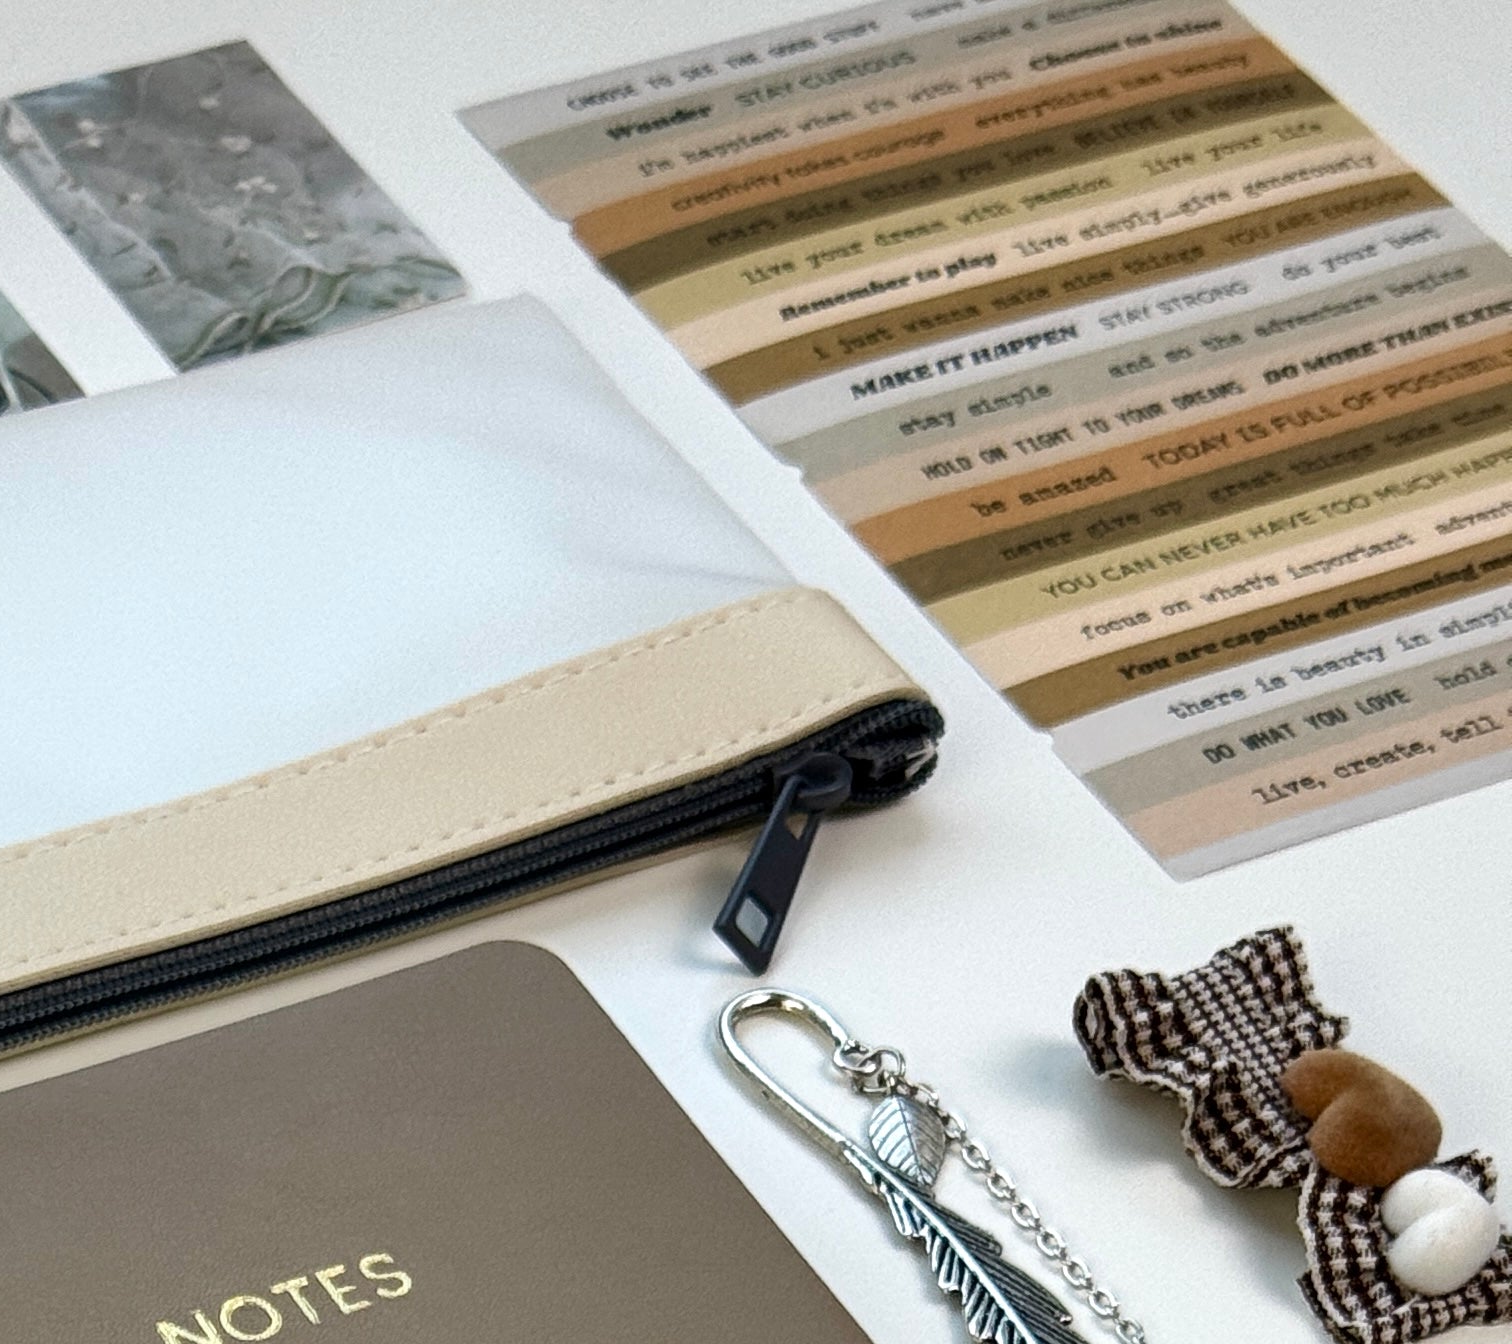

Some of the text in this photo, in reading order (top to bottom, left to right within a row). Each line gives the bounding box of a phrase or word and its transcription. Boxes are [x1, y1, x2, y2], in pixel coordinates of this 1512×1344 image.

[606, 106, 710, 139] Wonder
[1141, 151, 1195, 175] live
[1204, 133, 1262, 161] your
[671, 173, 780, 211] creativity
[783, 154, 849, 177] takes
[1012, 234, 1068, 256] live
[1242, 154, 1374, 196] generously
[741, 260, 795, 284] live
[805, 241, 862, 268] your
[955, 201, 1011, 224] with
[1019, 177, 1111, 208] passion
[1220, 224, 1270, 246] YOU
[1320, 243, 1377, 272] your
[779, 252, 996, 320] Remember to play
[1098, 280, 1248, 329] STAY STRONG
[838, 327, 893, 354] just
[851, 325, 1076, 395] MAKE IT HAPPEN
[1108, 354, 1154, 377] and
[1263, 364, 1298, 384] DO
[1302, 340, 1375, 370] MORE
[1378, 319, 1449, 348] THAN
[899, 384, 1051, 434] stay simple
[921, 380, 1243, 478] HOLD ON TIGHT TO YOUR DREAMS
[1141, 432, 1229, 467] TODAY
[1234, 422, 1270, 442] IS
[1269, 404, 1342, 432] FULL
[1340, 390, 1376, 410] OF
[970, 466, 1116, 516] be amazed
[999, 499, 1183, 560] never give up
[1040, 573, 1097, 597] YOU
[1100, 556, 1156, 581] CAN
[1158, 530, 1244, 564] NEVER
[1246, 510, 1316, 538] HAVE
[1316, 493, 1371, 517] TOO
[1372, 469, 1448, 500] MUCH
[1080, 532, 1414, 639] focus on what's important
[1118, 563, 1478, 679] You are capable of becoming
[1168, 688, 1246, 718] there
[1255, 675, 1287, 692] is
[1291, 645, 1385, 679] beauty
[1395, 633, 1431, 651] in
[1433, 660, 1497, 689] hold
[1202, 688, 1410, 763] DO WHAT YOU LOVE
[1252, 715, 1502, 803] live, create, tell
